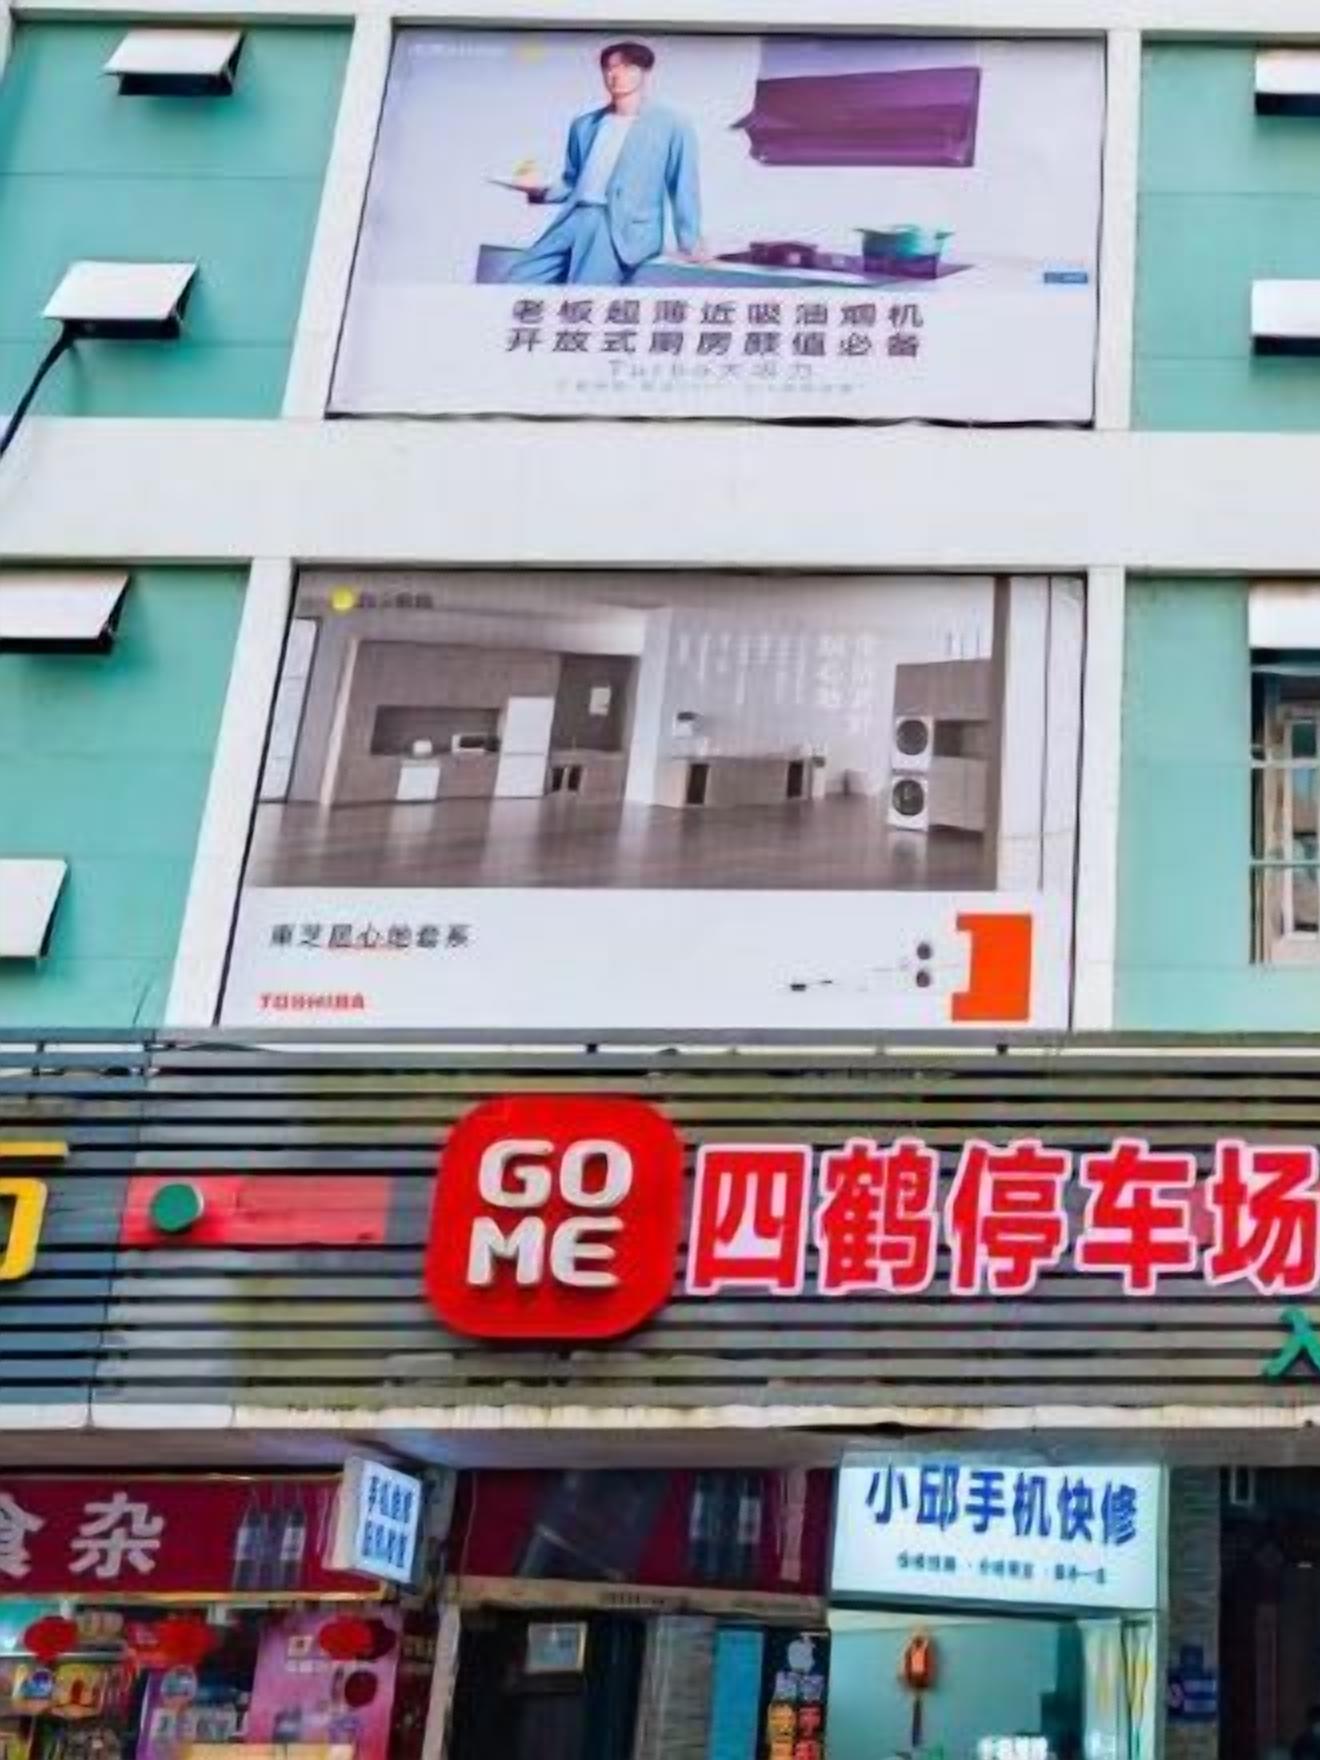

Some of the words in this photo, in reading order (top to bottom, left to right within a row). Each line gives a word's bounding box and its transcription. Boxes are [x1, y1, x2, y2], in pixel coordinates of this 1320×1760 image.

[506, 328, 920, 358] 开放式厨房颜值必备
[512, 299, 924, 328] 老板超薄近吸油烟机
[478, 1139, 633, 1208] GO
[467, 1215, 624, 1288] ME
[865, 1462, 1139, 1546] 小邱手机快修
